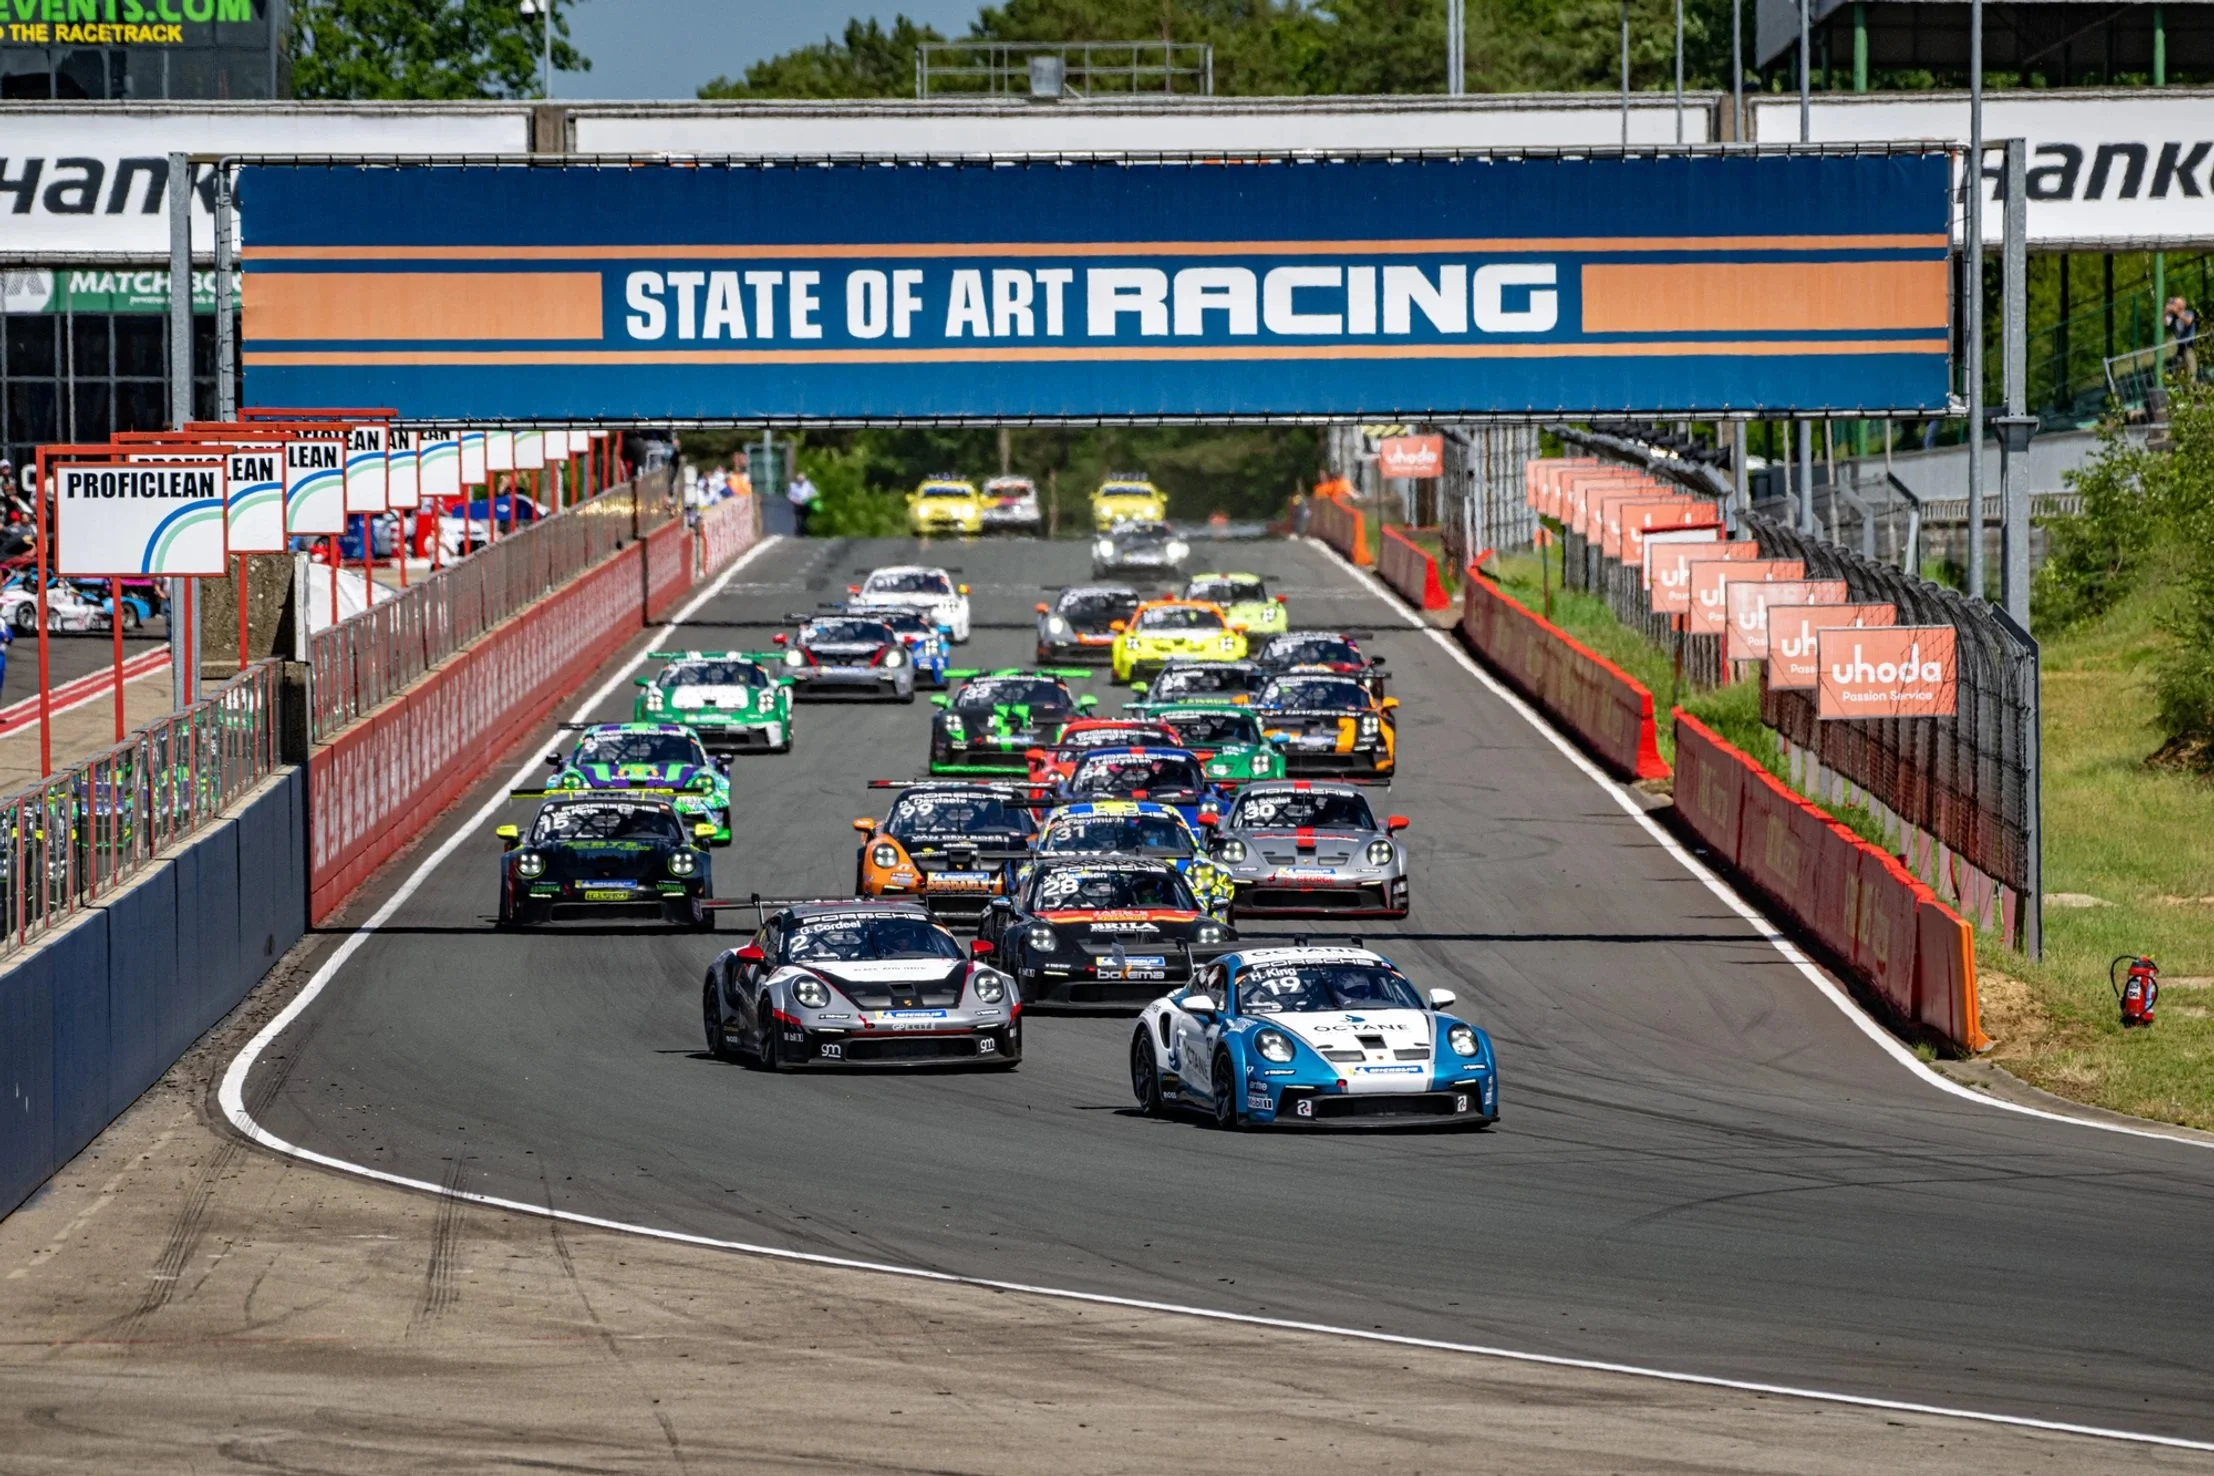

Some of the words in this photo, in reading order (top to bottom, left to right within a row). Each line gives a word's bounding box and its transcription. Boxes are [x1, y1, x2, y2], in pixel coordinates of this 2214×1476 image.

[9, 24, 48, 42] THE
[55, 23, 183, 43] RACETRACK
[1957, 141, 2214, 202] ank
[0, 157, 242, 215] Hank
[626, 269, 822, 340] STATE
[846, 268, 924, 339] OF
[945, 267, 1073, 338] ART
[1087, 263, 1558, 336] RACING
[67, 471, 214, 498] PROFICLEAN
[1831, 642, 1942, 684] uhoda
[1842, 689, 1887, 703] Passion
[1890, 688, 1933, 701] Service
[900, 801, 935, 820] 99
[1243, 804, 1276, 820] 30
[1055, 826, 1086, 841] 31
[1043, 878, 1080, 897] 28
[800, 924, 813, 935] G.
[814, 920, 862, 933] Cordeel
[803, 912, 928, 925] PORSCHE
[788, 934, 810, 952] 2
[1252, 957, 1375, 970] PORSCHE
[1250, 970, 1266, 982] H.
[1267, 966, 1298, 979] King
[1261, 976, 1302, 996] 19
[1313, 1023, 1409, 1033] OCTANE
